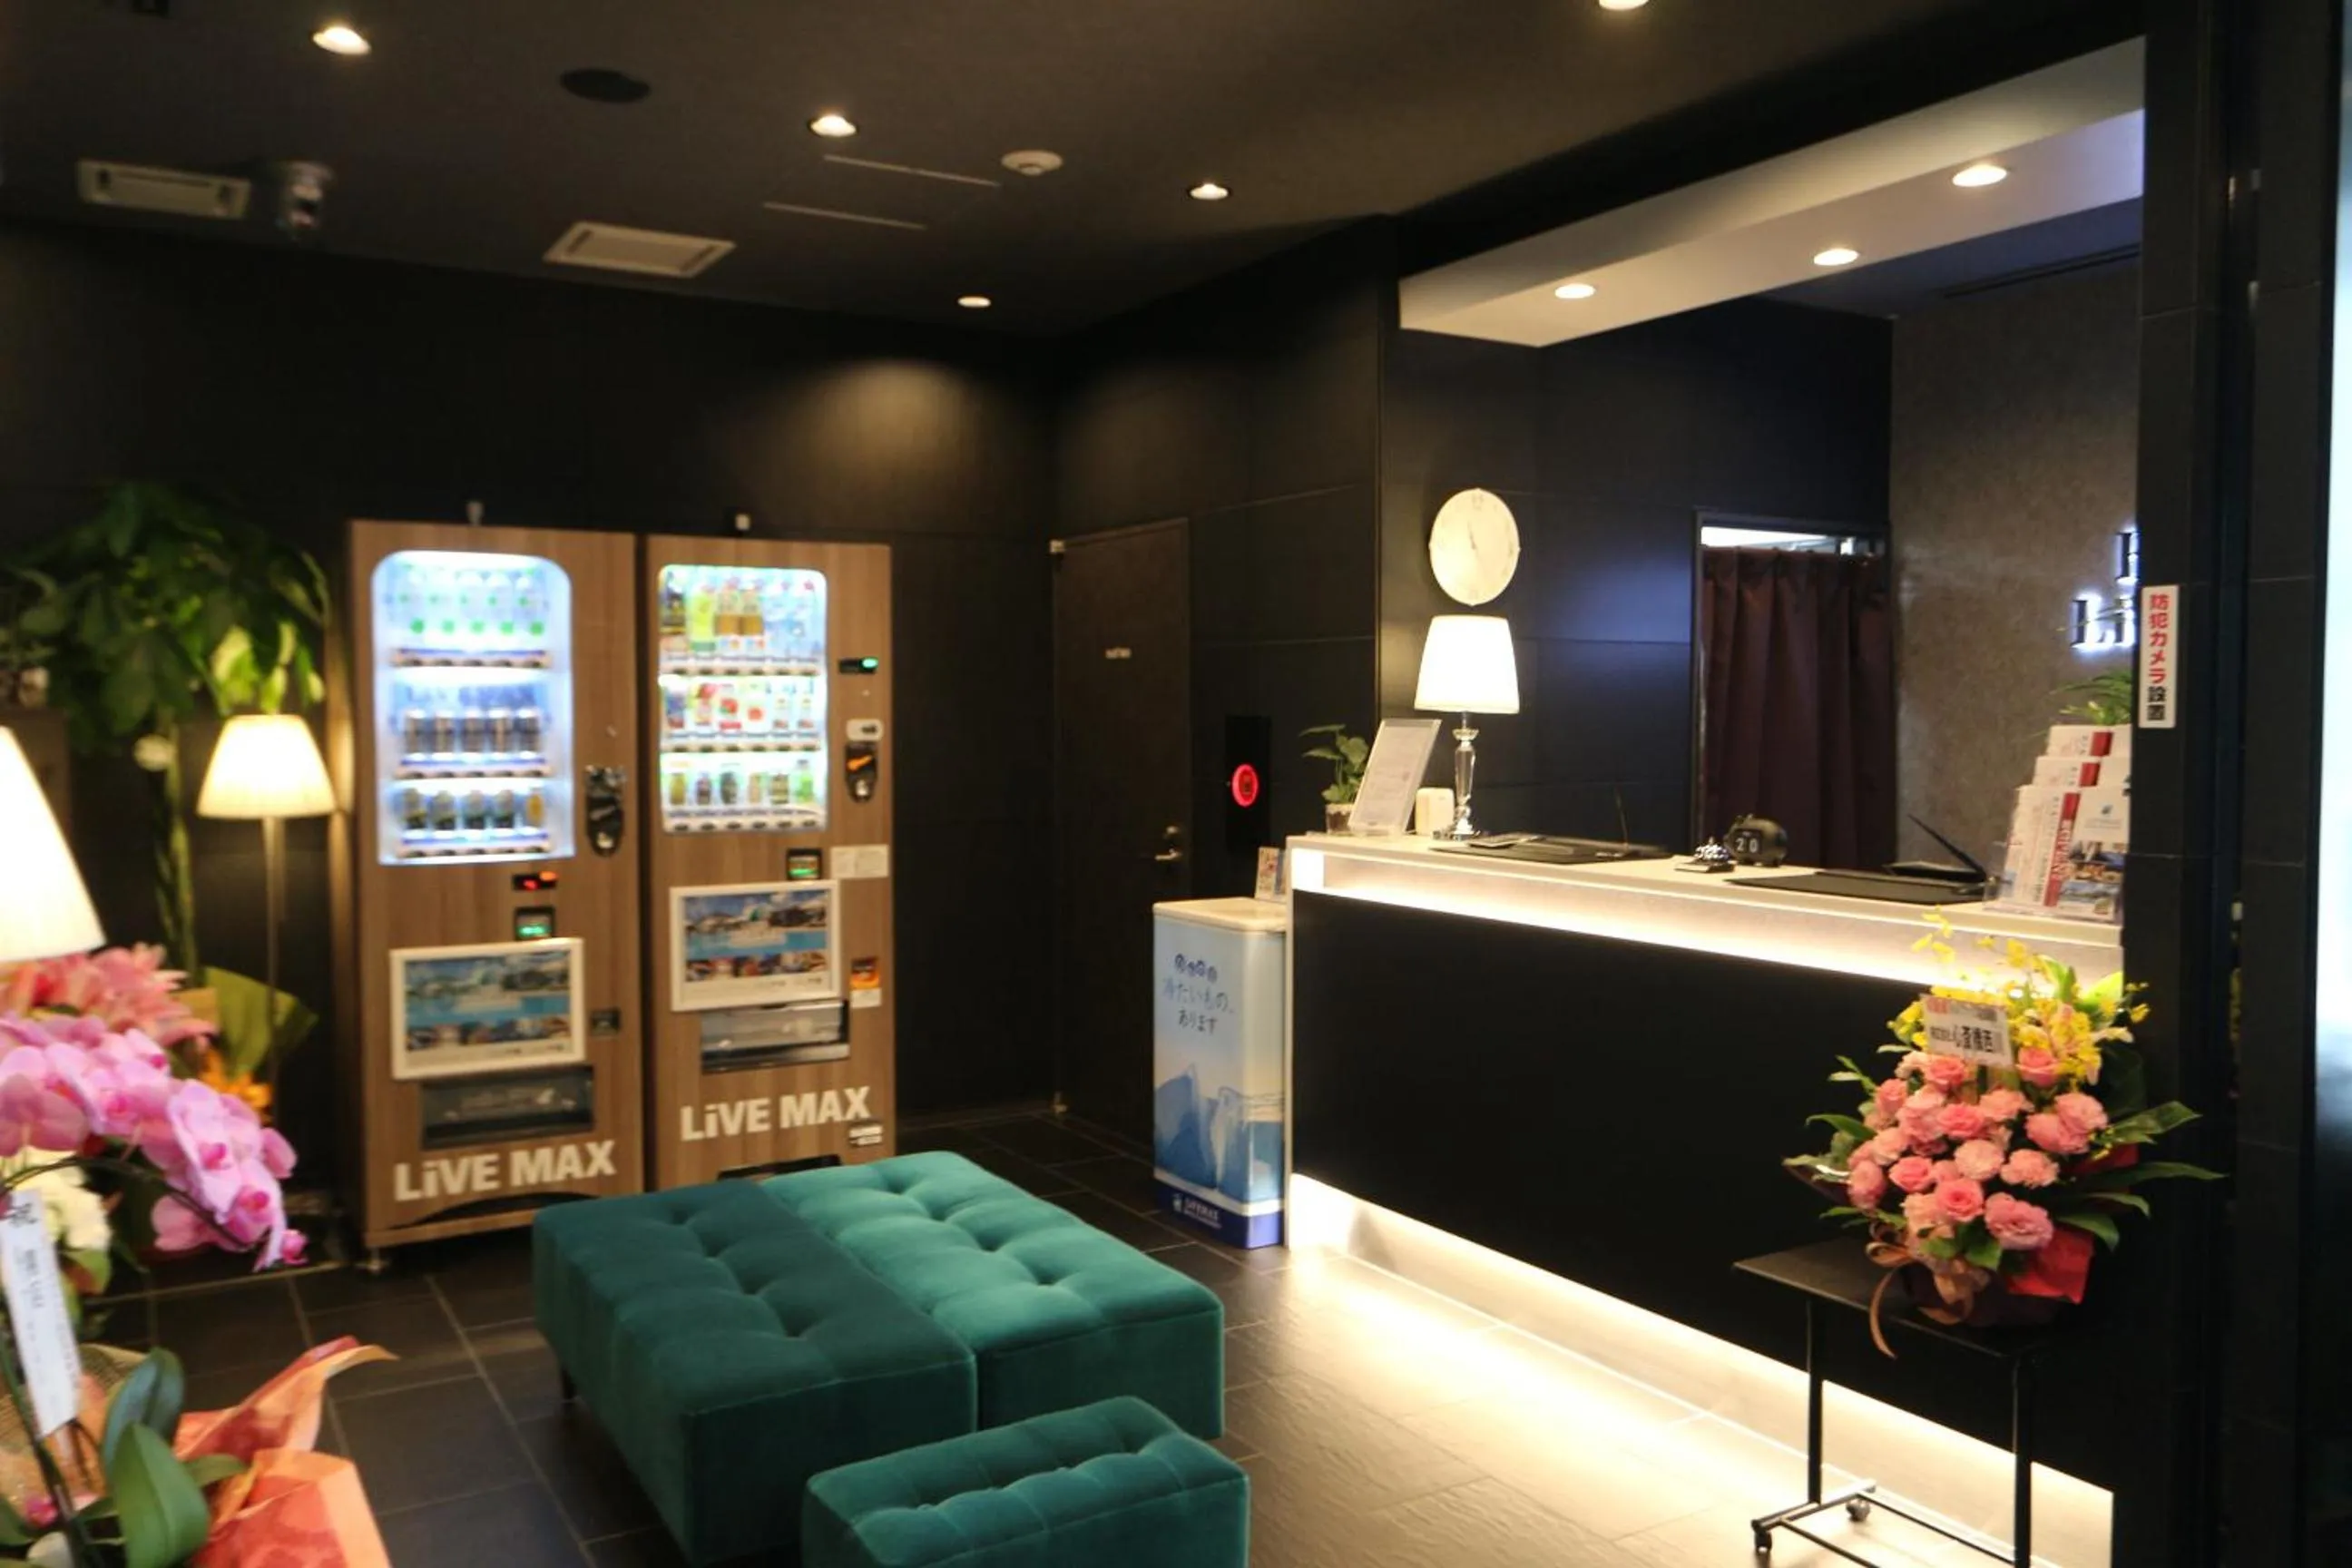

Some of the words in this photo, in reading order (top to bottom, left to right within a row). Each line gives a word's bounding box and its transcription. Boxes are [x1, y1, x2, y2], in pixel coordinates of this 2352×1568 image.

[2147, 594, 2169, 720] 防犯カメラ設置
[681, 1099, 769, 1142] LiVE
[780, 1087, 870, 1129] MAX
[395, 1153, 500, 1201] LiVE
[511, 1141, 616, 1187] MAX
